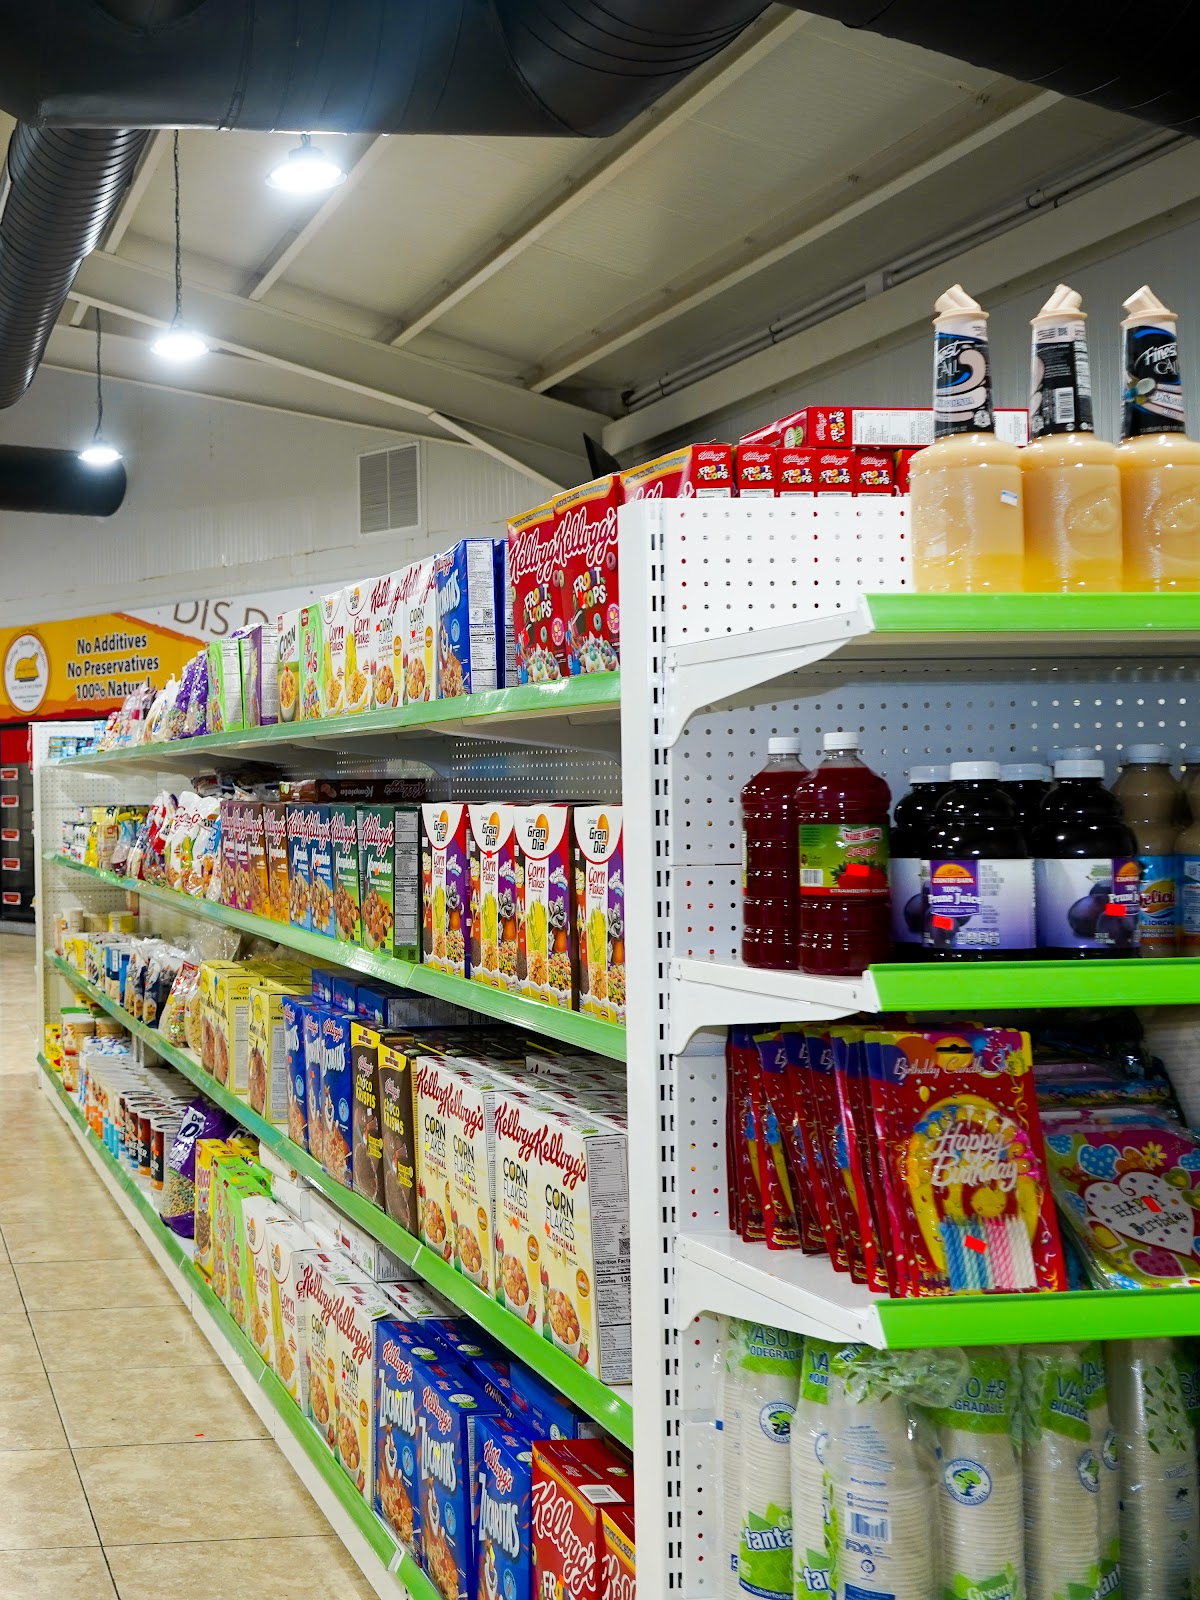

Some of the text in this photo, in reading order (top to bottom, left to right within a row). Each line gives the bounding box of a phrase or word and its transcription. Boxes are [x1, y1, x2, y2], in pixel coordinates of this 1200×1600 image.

[704, 472, 729, 482] LOOPS
[748, 472, 773, 482] LOOPS
[788, 475, 813, 484] LOOPS
[825, 475, 851, 484] LOOPS
[866, 477, 891, 485] LOOPS
[509, 528, 557, 584] Kellogg
[553, 506, 618, 567] Kellogg's
[579, 585, 607, 609] OOPS
[529, 600, 552, 623] LOOPS
[77, 634, 147, 654] No Additives
[67, 656, 159, 677] No Preservatives
[76, 677, 151, 699] 100% Naturl
[362, 812, 394, 857] Kellogg's
[433, 820, 448, 832] Gran
[481, 823, 498, 835] Gran
[527, 825, 546, 839] Gran
[589, 827, 607, 841] Gran
[433, 851, 445, 866] Corn
[433, 863, 445, 875] Flakes
[482, 857, 496, 872] Corn
[528, 862, 546, 878] Corn
[483, 870, 496, 882] Flakes
[528, 876, 545, 890] Flakes
[588, 867, 606, 884] Corn
[588, 881, 605, 896] Flakes
[942, 885, 962, 893] 100%
[954, 893, 983, 905] Juice
[893, 1057, 940, 1080] Birthday
[943, 1057, 984, 1074] Candle
[356, 1084, 376, 1109] KRISPIS
[443, 1083, 484, 1139] Kellogg's
[425, 1113, 446, 1140] CORN
[425, 1132, 446, 1158] FAKES
[453, 1135, 475, 1164] CORN
[927, 1122, 1010, 1166] Happy
[534, 1124, 587, 1190] Kellogg's
[503, 1157, 528, 1189] CORN
[931, 1150, 1018, 1192] Birthday
[503, 1179, 528, 1209] FLAKES
[545, 1184, 575, 1221] CORN
[508, 1204, 529, 1222] ORIGINAL
[1112, 1194, 1166, 1219] HAPY
[546, 1208, 575, 1241] FLAKES
[1130, 1211, 1189, 1236] Birthday
[552, 1233, 577, 1255] ORIGINAL
[311, 1314, 326, 1341] CORN
[334, 1296, 373, 1365] Kellogg's
[341, 1351, 359, 1383] CORN
[383, 1339, 413, 1385] Kellogg's
[342, 1372, 358, 1398] LAKES
[379, 1368, 416, 1437] ZUCARITAS
[422, 1386, 453, 1435] Kellogg's
[418, 1416, 456, 1492] ZUCARITAS
[484, 1438, 514, 1495] Kellogg's
[479, 1471, 520, 1559] ZUCARITAS
[532, 1480, 597, 1595] Kellogg's
